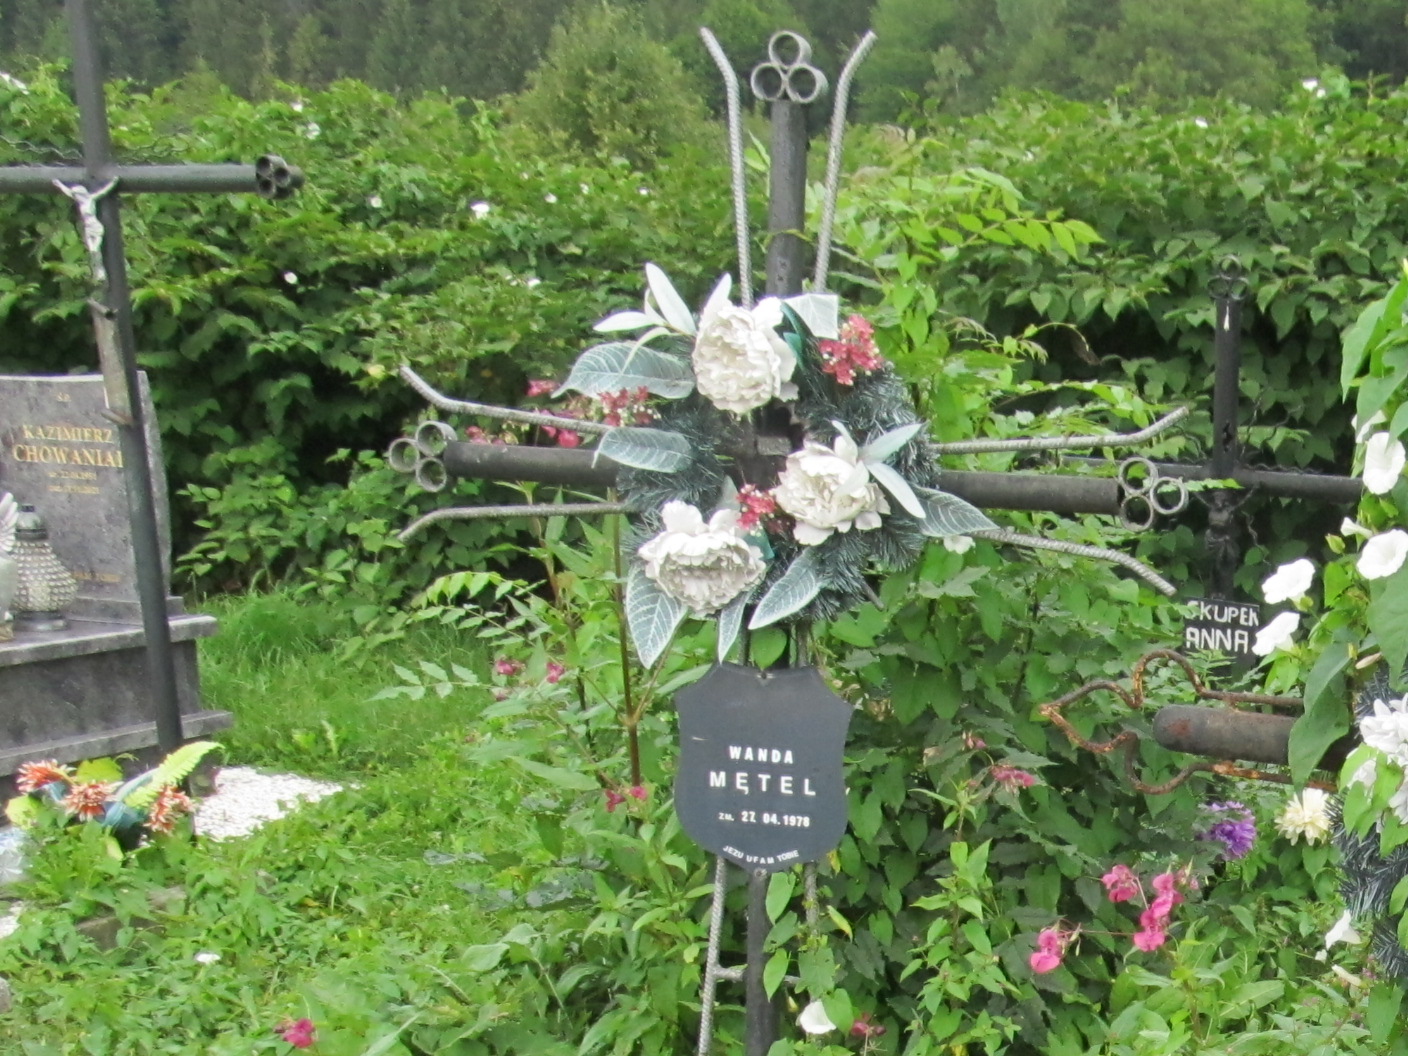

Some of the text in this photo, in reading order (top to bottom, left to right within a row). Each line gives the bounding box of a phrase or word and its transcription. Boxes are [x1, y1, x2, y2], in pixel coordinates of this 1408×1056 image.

[1186, 627, 1249, 654] ANNA
[729, 745, 794, 764] WANDA
[709, 771, 817, 796] MĘTEL
[722, 845, 800, 864] JEZU UFAM TOBIE
